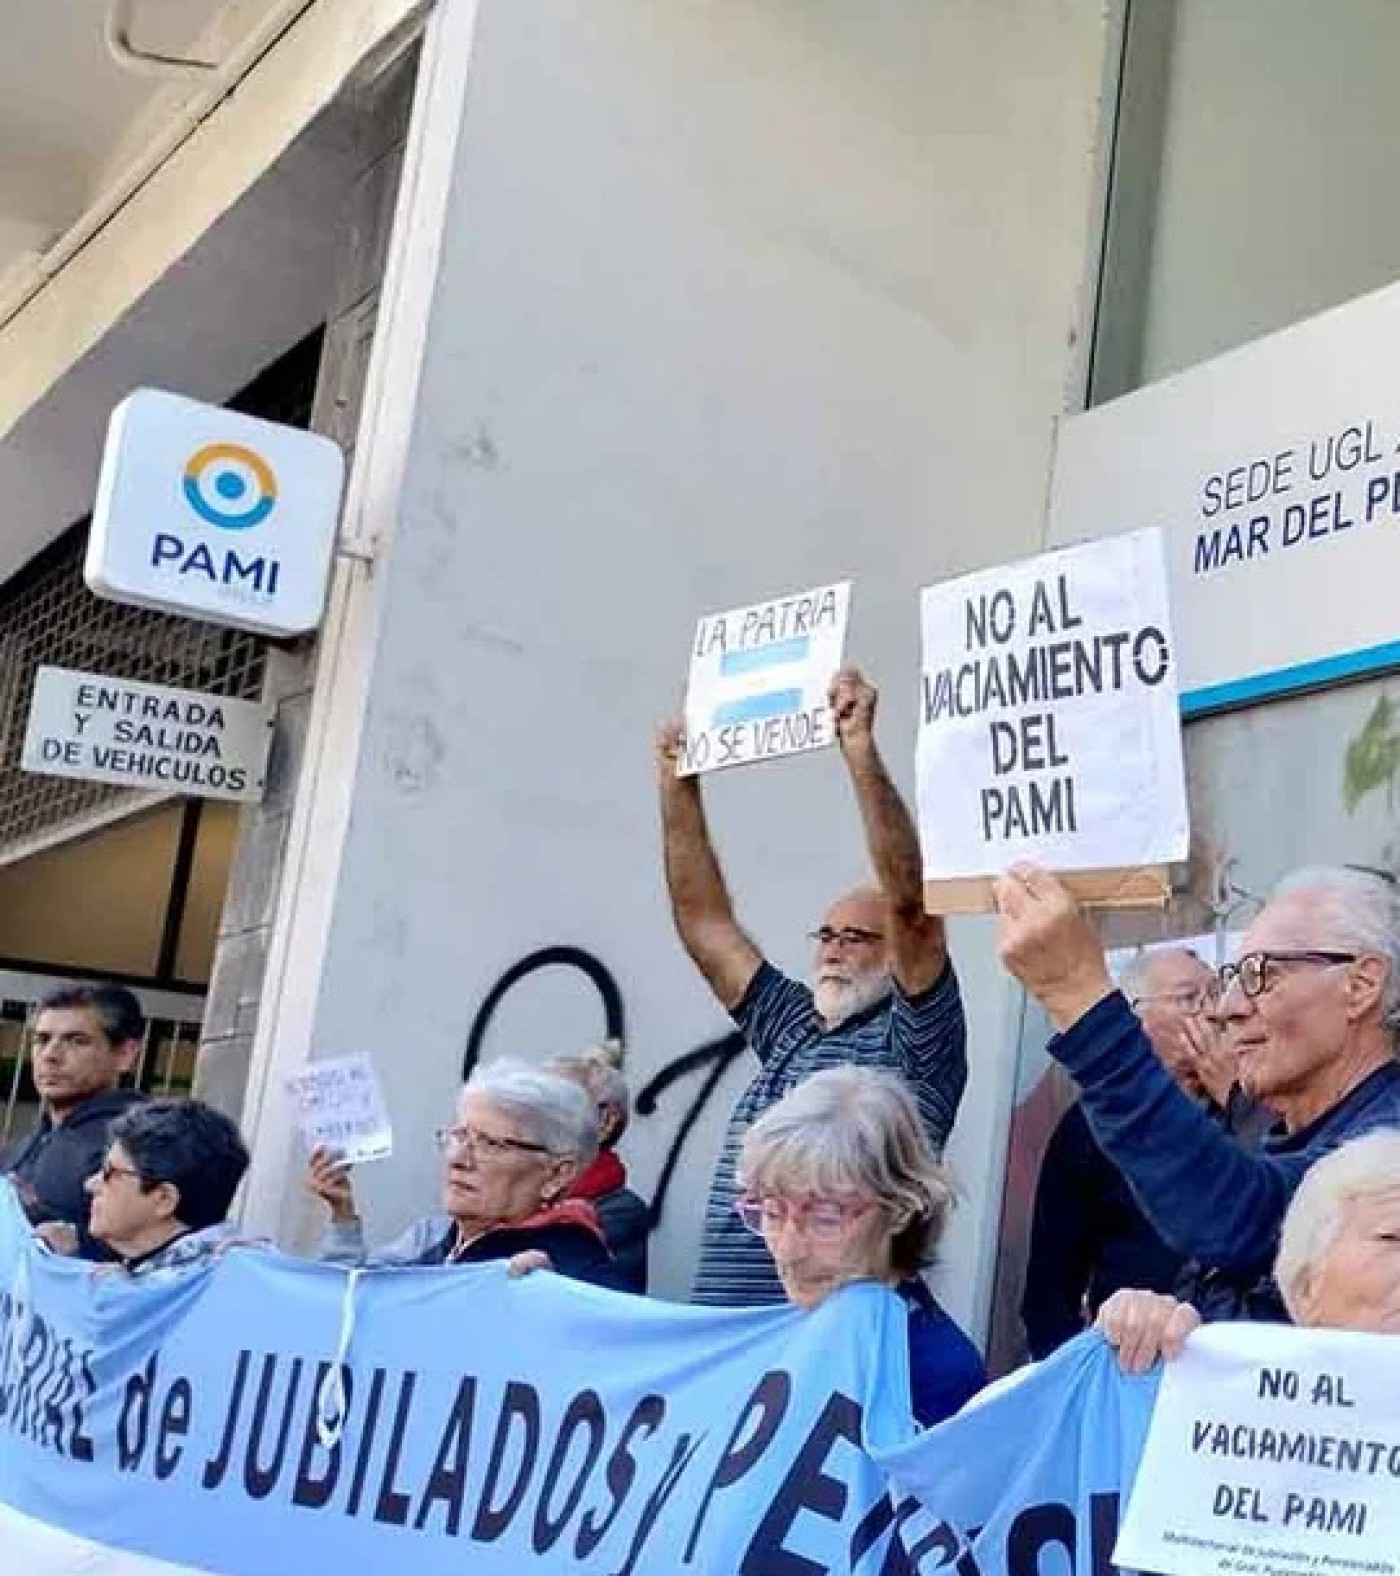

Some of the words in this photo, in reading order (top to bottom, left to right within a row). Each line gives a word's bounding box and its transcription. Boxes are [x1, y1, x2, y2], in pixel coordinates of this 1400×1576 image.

[1201, 450, 1294, 517] SEDE
[1308, 420, 1382, 481] UGL
[1194, 516, 1271, 574] MAR
[1282, 491, 1354, 547] DEL
[152, 533, 281, 595] PAMI
[697, 618, 727, 657] LA
[739, 589, 836, 646] PATRIA
[965, 589, 1016, 650] NO
[1029, 575, 1083, 636] AL
[922, 625, 1170, 723] VACIAMIENTO
[74, 714, 90, 733] Y
[113, 721, 222, 758] SALIDA
[77, 685, 227, 730] ENTRADA
[718, 725, 746, 763] SE
[753, 705, 826, 757] VENDE
[42, 738, 83, 765] DE
[93, 746, 247, 790] VEHICULOS
[990, 713, 1069, 775] DEL
[980, 776, 1077, 841] PAMI
[1258, 1367, 1299, 1400] NO
[1311, 1373, 1354, 1407] AL
[117, 1350, 193, 1480] de
[201, 1349, 667, 1560] JUBILADOS
[1213, 1484, 1268, 1523] DEL
[1283, 1494, 1367, 1536] PAMI
